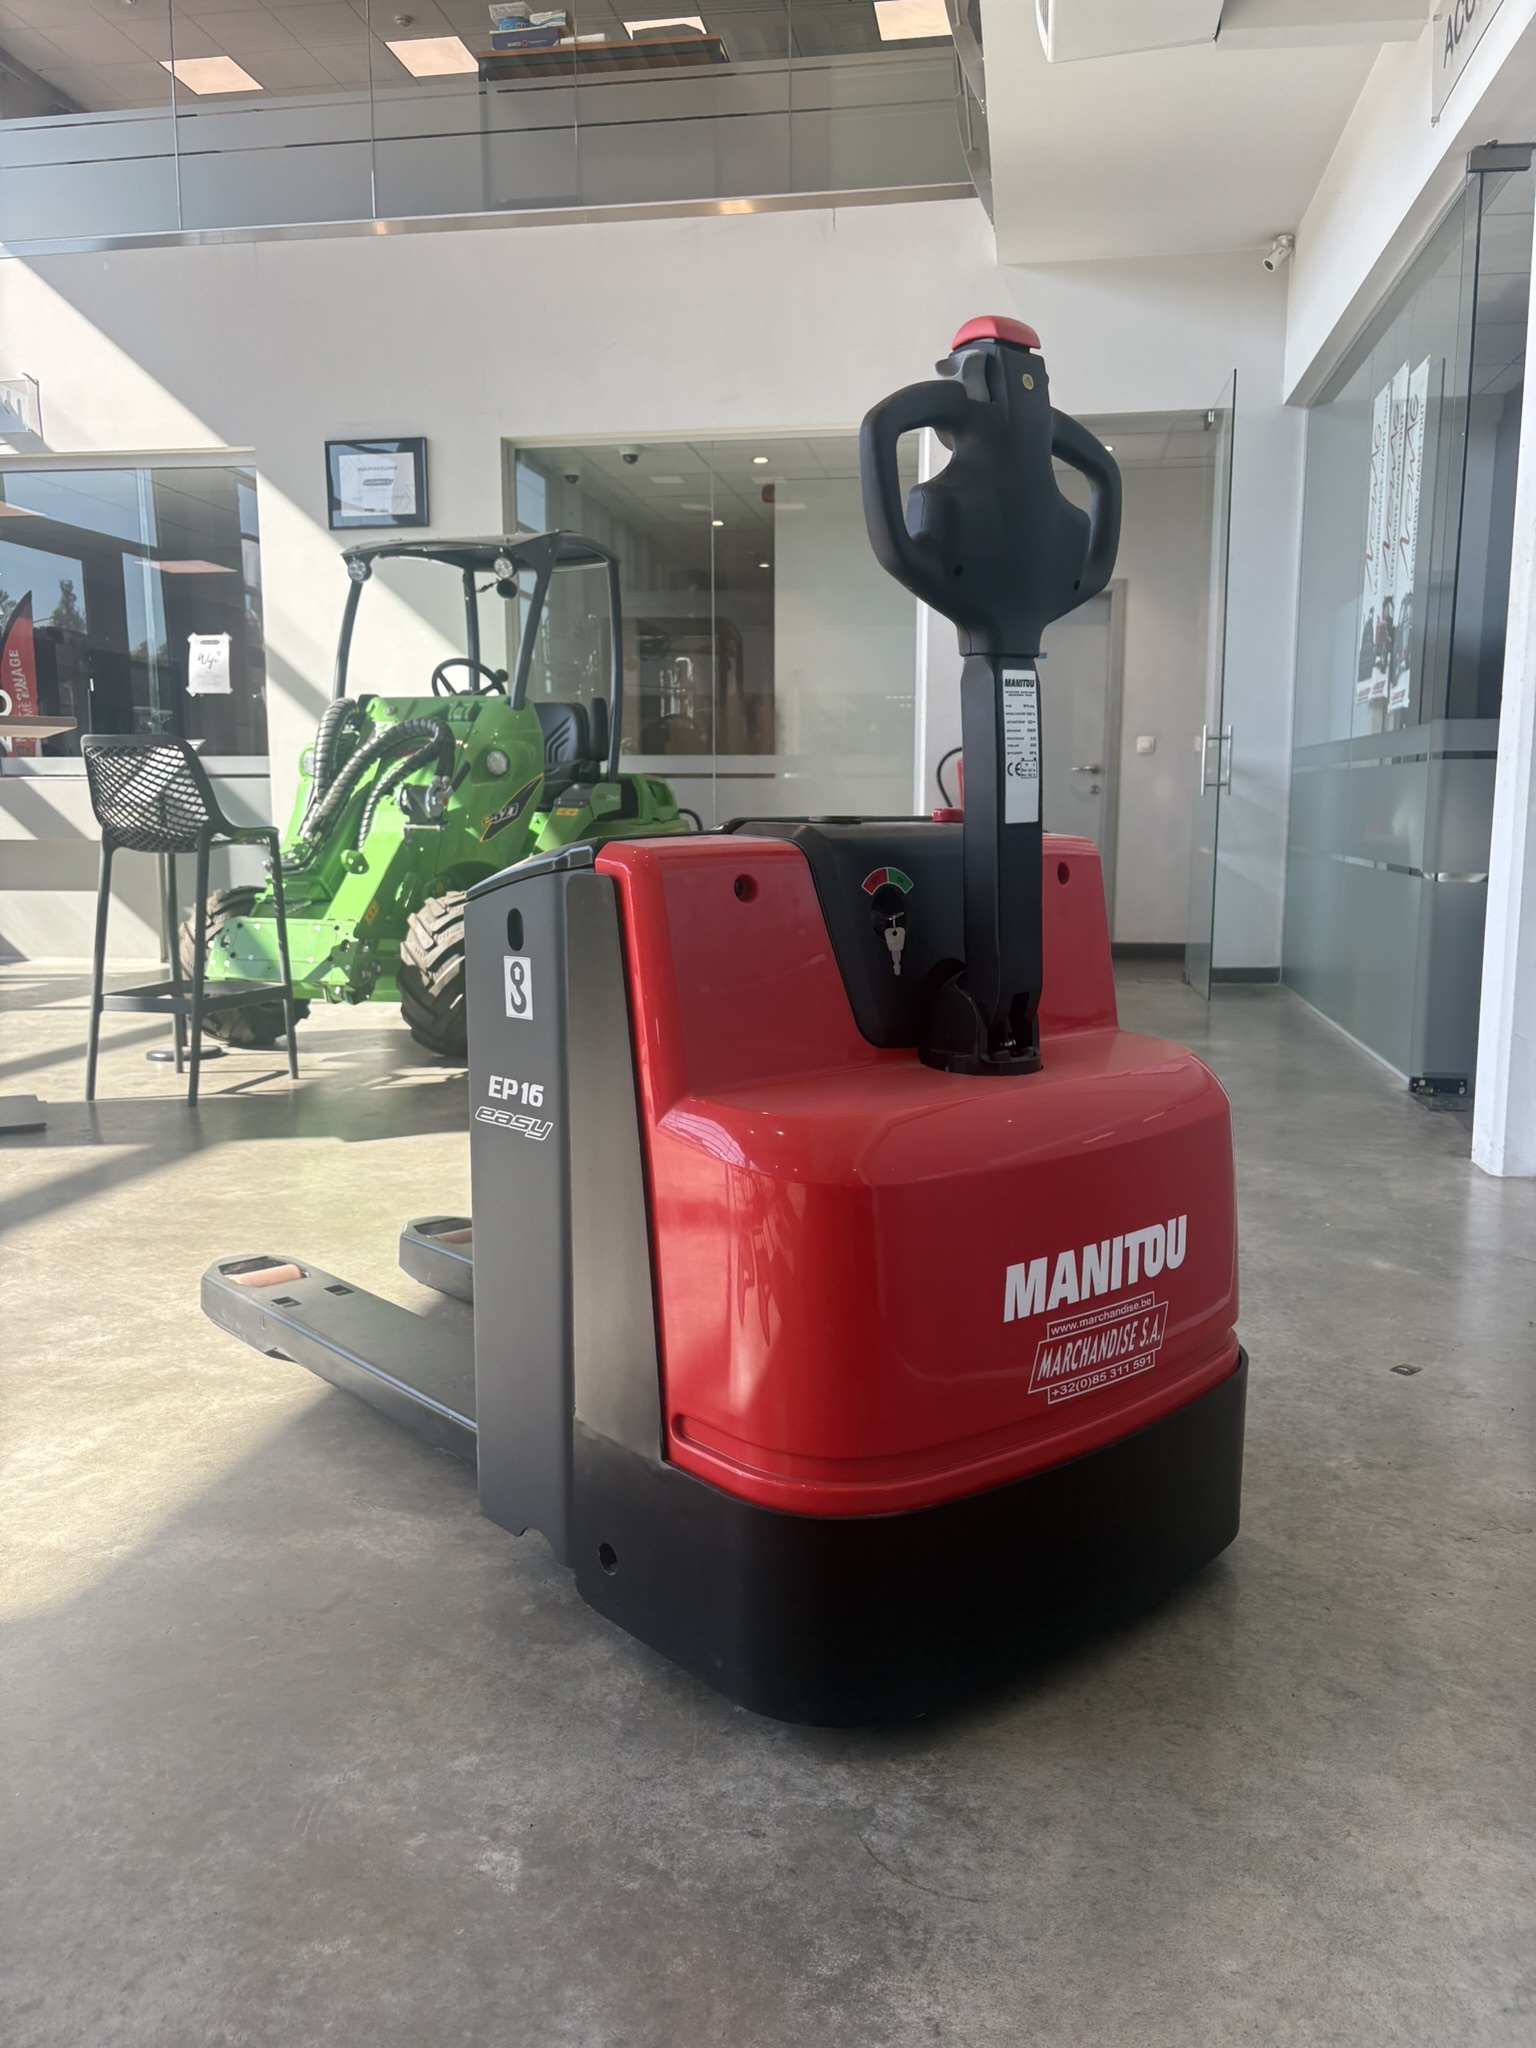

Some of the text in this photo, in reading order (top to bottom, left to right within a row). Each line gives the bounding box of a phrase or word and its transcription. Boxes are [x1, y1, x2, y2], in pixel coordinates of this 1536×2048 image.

[1004, 678, 1035, 688] MANITOU
[475, 1105, 554, 1141] easy
[1003, 1214, 1187, 1323] MANITOU
[1051, 1298, 1152, 1336] www.marchandise.be
[1037, 1313, 1161, 1381] MARCHANDISE S.A.
[1051, 1355, 1152, 1397] +32(0)85 311 591
